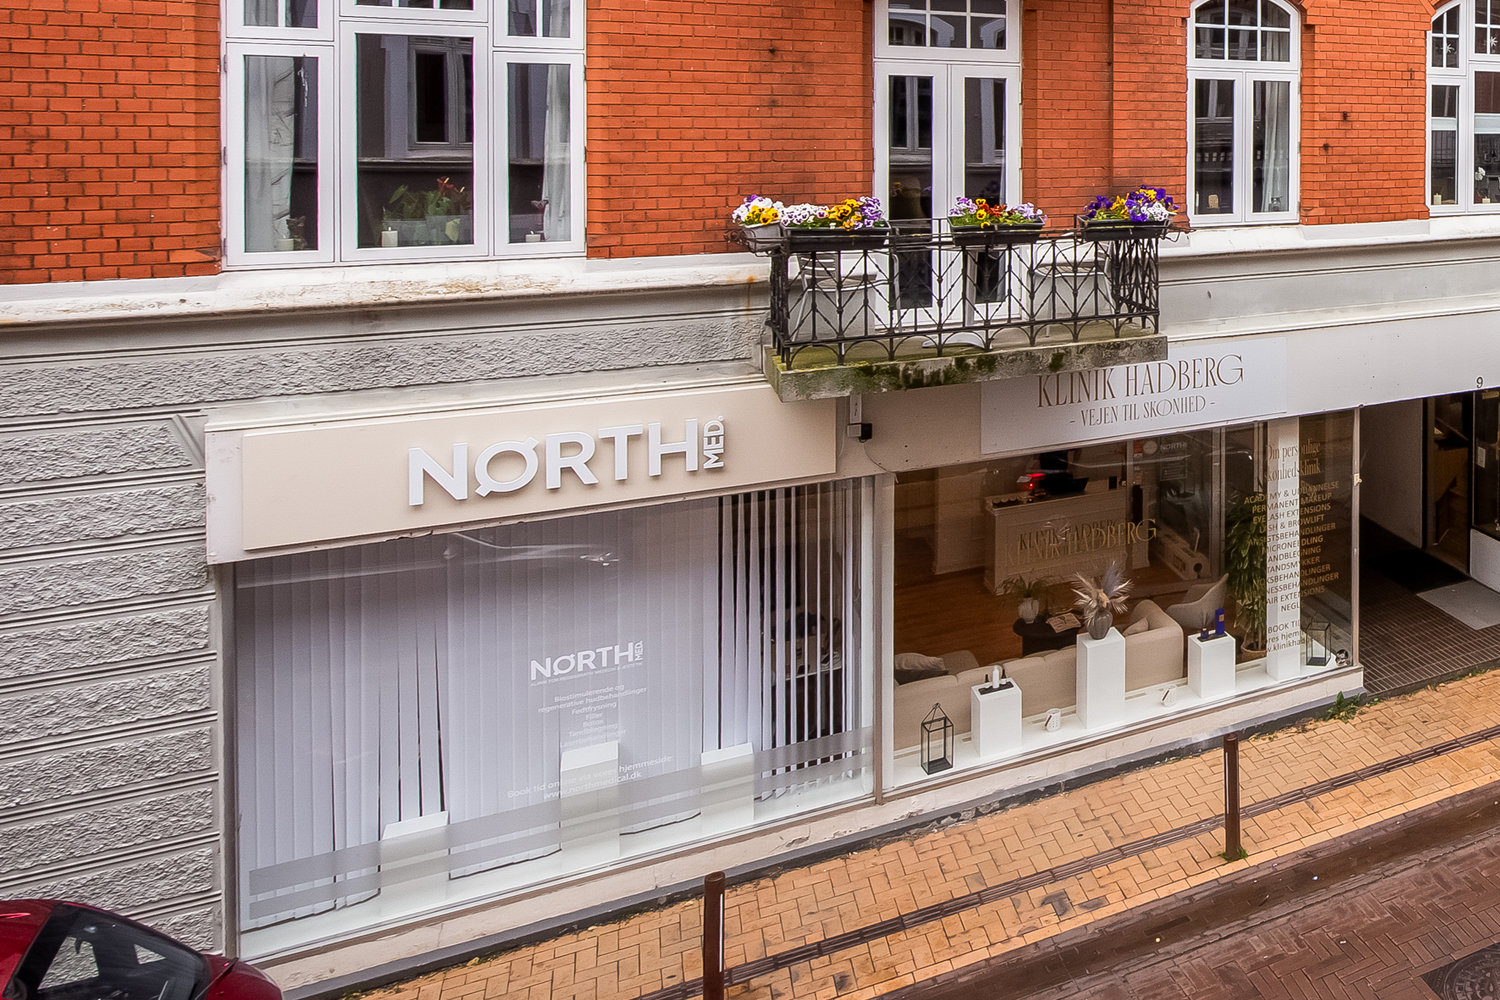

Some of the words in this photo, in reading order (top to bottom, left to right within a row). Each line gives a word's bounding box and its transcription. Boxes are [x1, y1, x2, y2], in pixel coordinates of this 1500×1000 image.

[1037, 367, 1117, 408] KLINIK
[1124, 354, 1244, 398] HADBERG
[1476, 376, 1484, 389] 9
[1081, 404, 1119, 427] VEJEN
[1122, 402, 1140, 422] TIL
[1143, 395, 1207, 419] SKØNHED
[408, 418, 698, 506] NØRTH
[1243, 490, 1282, 505] ACADMY
[1283, 489, 1290, 498] &
[1301, 492, 1333, 505] MAKEUP
[1279, 521, 1286, 529] &
[1264, 545, 1322, 564] ANDBLEGNING
[1267, 622, 1290, 635] BOOK
[530, 641, 634, 681] NØRTH
[614, 684, 625, 693] og
[507, 785, 531, 799] Book
